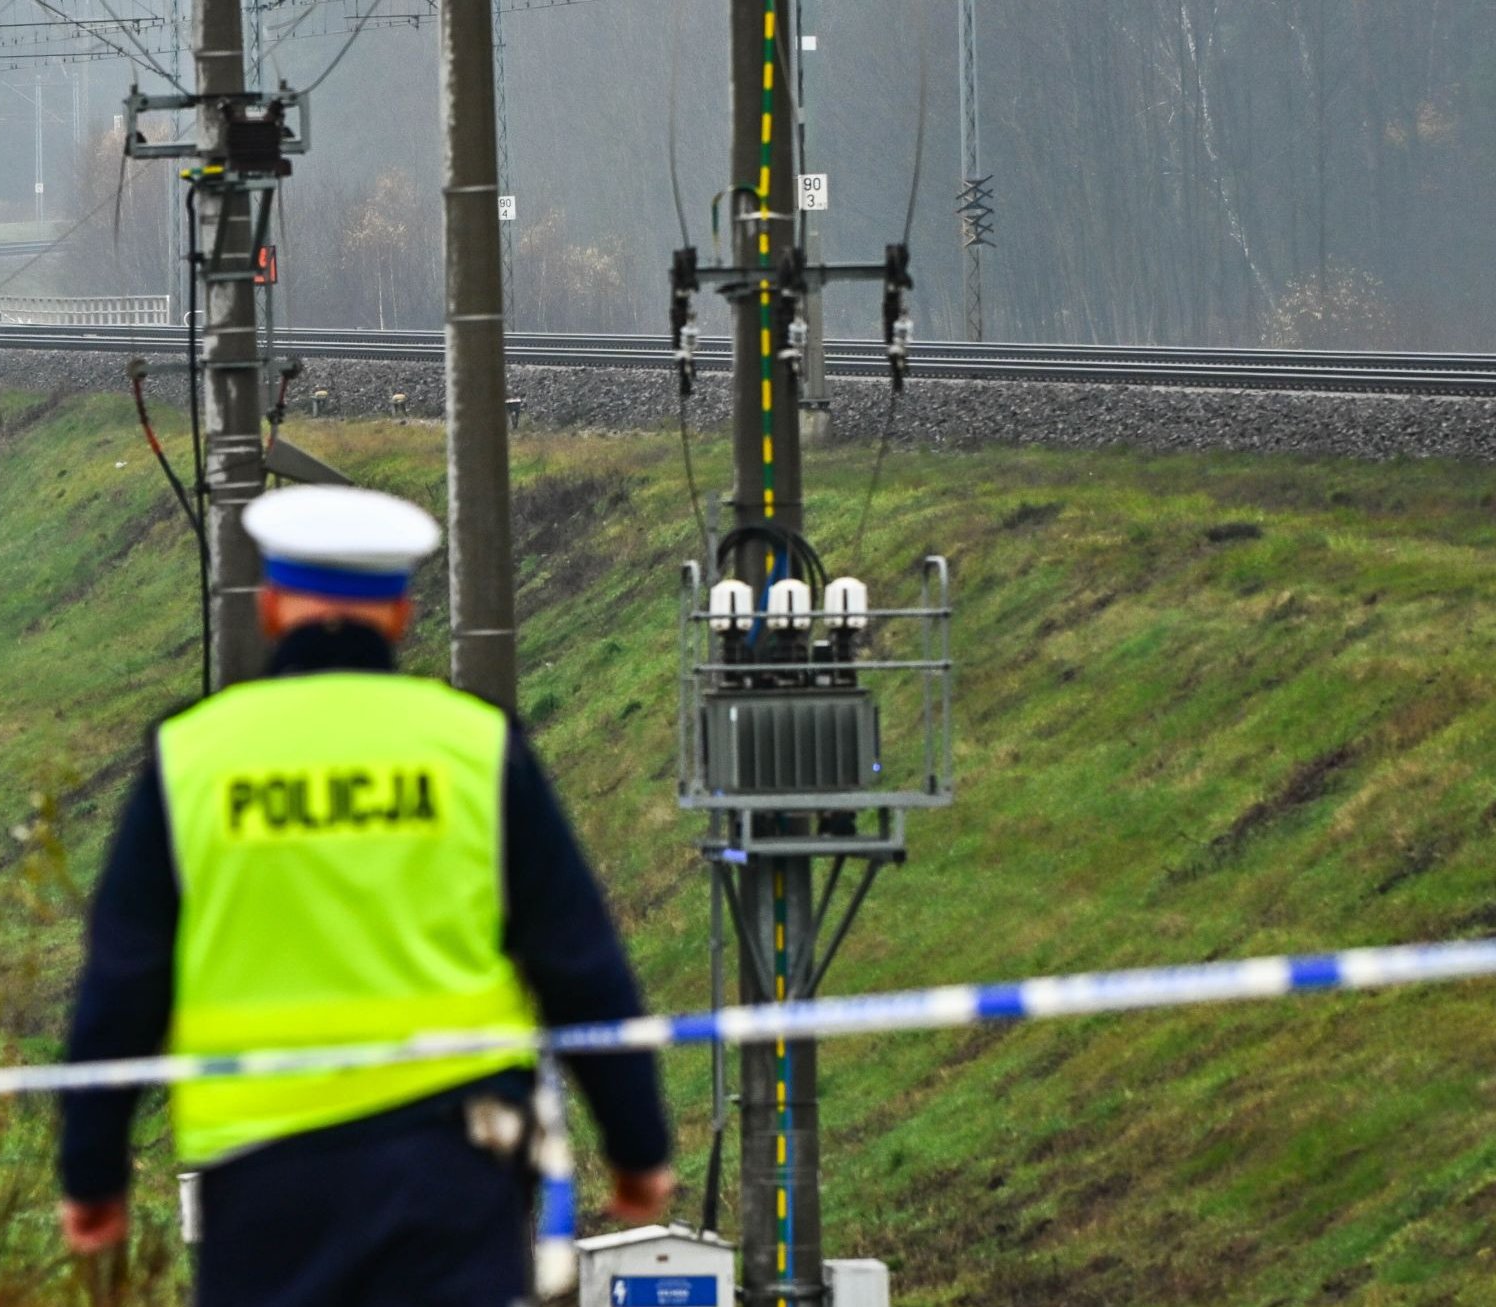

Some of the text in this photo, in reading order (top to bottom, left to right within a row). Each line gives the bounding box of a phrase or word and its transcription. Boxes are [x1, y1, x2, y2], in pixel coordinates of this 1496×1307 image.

[803, 177, 821, 191] 90
[499, 199, 511, 208] 90
[807, 194, 815, 207] 3
[502, 210, 508, 218] 4
[227, 770, 437, 832] POLICJA
